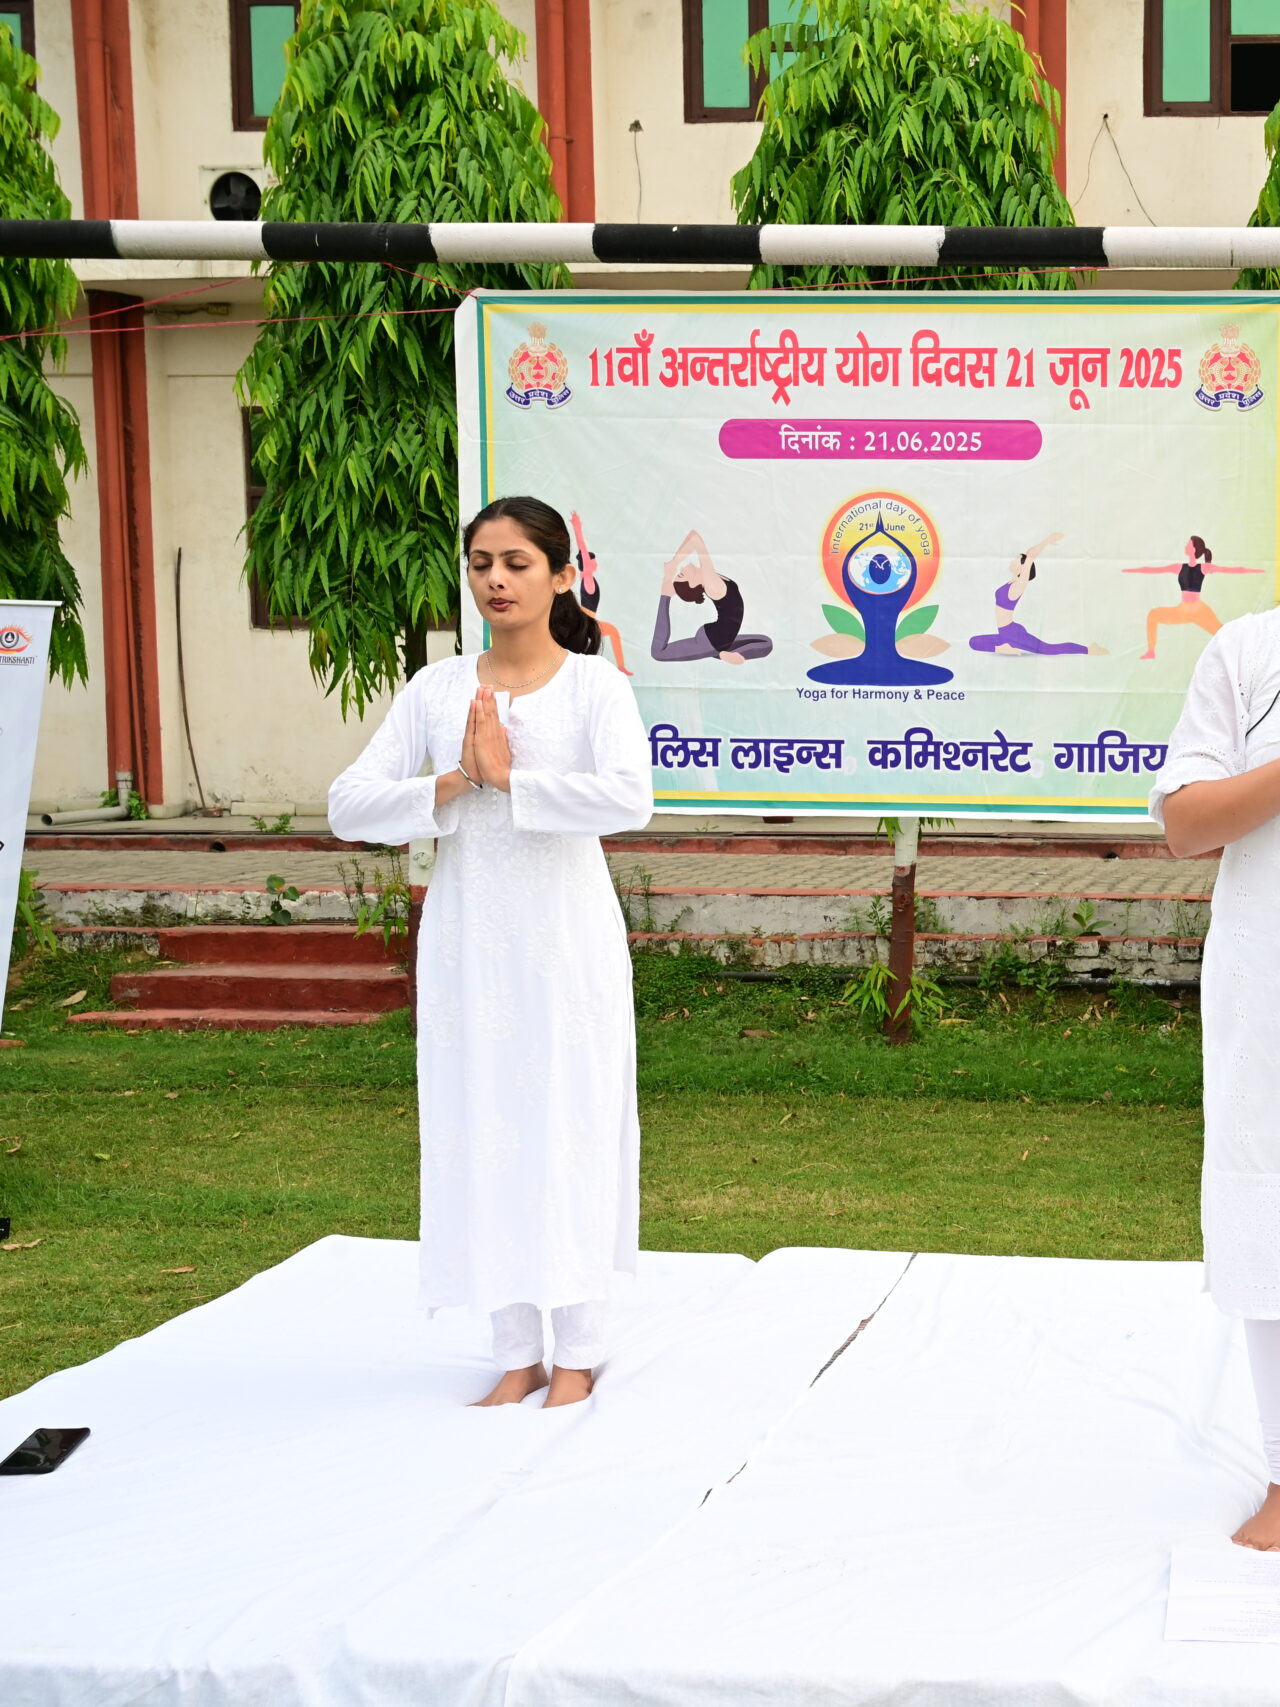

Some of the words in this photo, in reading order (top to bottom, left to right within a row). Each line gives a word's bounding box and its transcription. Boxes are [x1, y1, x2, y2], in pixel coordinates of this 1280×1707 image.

[588, 328, 655, 388] 11वाँ
[658, 328, 827, 407] अन्तर्राष्ट्रीय
[835, 330, 902, 388] योग
[909, 329, 998, 389] दिवस
[1006, 347, 1036, 389] 21
[1046, 347, 1111, 410] जून
[1118, 347, 1183, 389] 2025
[778, 424, 842, 452] दिनांक
[864, 431, 983, 453] 21.06.2025
[831, 499, 882, 554] International
[885, 501, 907, 516] day
[908, 513, 921, 525] of
[915, 525, 931, 556] yoga
[859, 522, 874, 531] 21st
[884, 523, 906, 531] June
[796, 687, 827, 701] Yoga
[831, 687, 849, 699] for
[852, 688, 909, 703] Harmony
[914, 689, 923, 700] &
[927, 689, 965, 700] Peace
[648, 723, 722, 769] लिस
[729, 738, 845, 773] लाइन्स
[868, 727, 1033, 774] कमिश्नरेट
[1053, 730, 1169, 773] गाजिय
